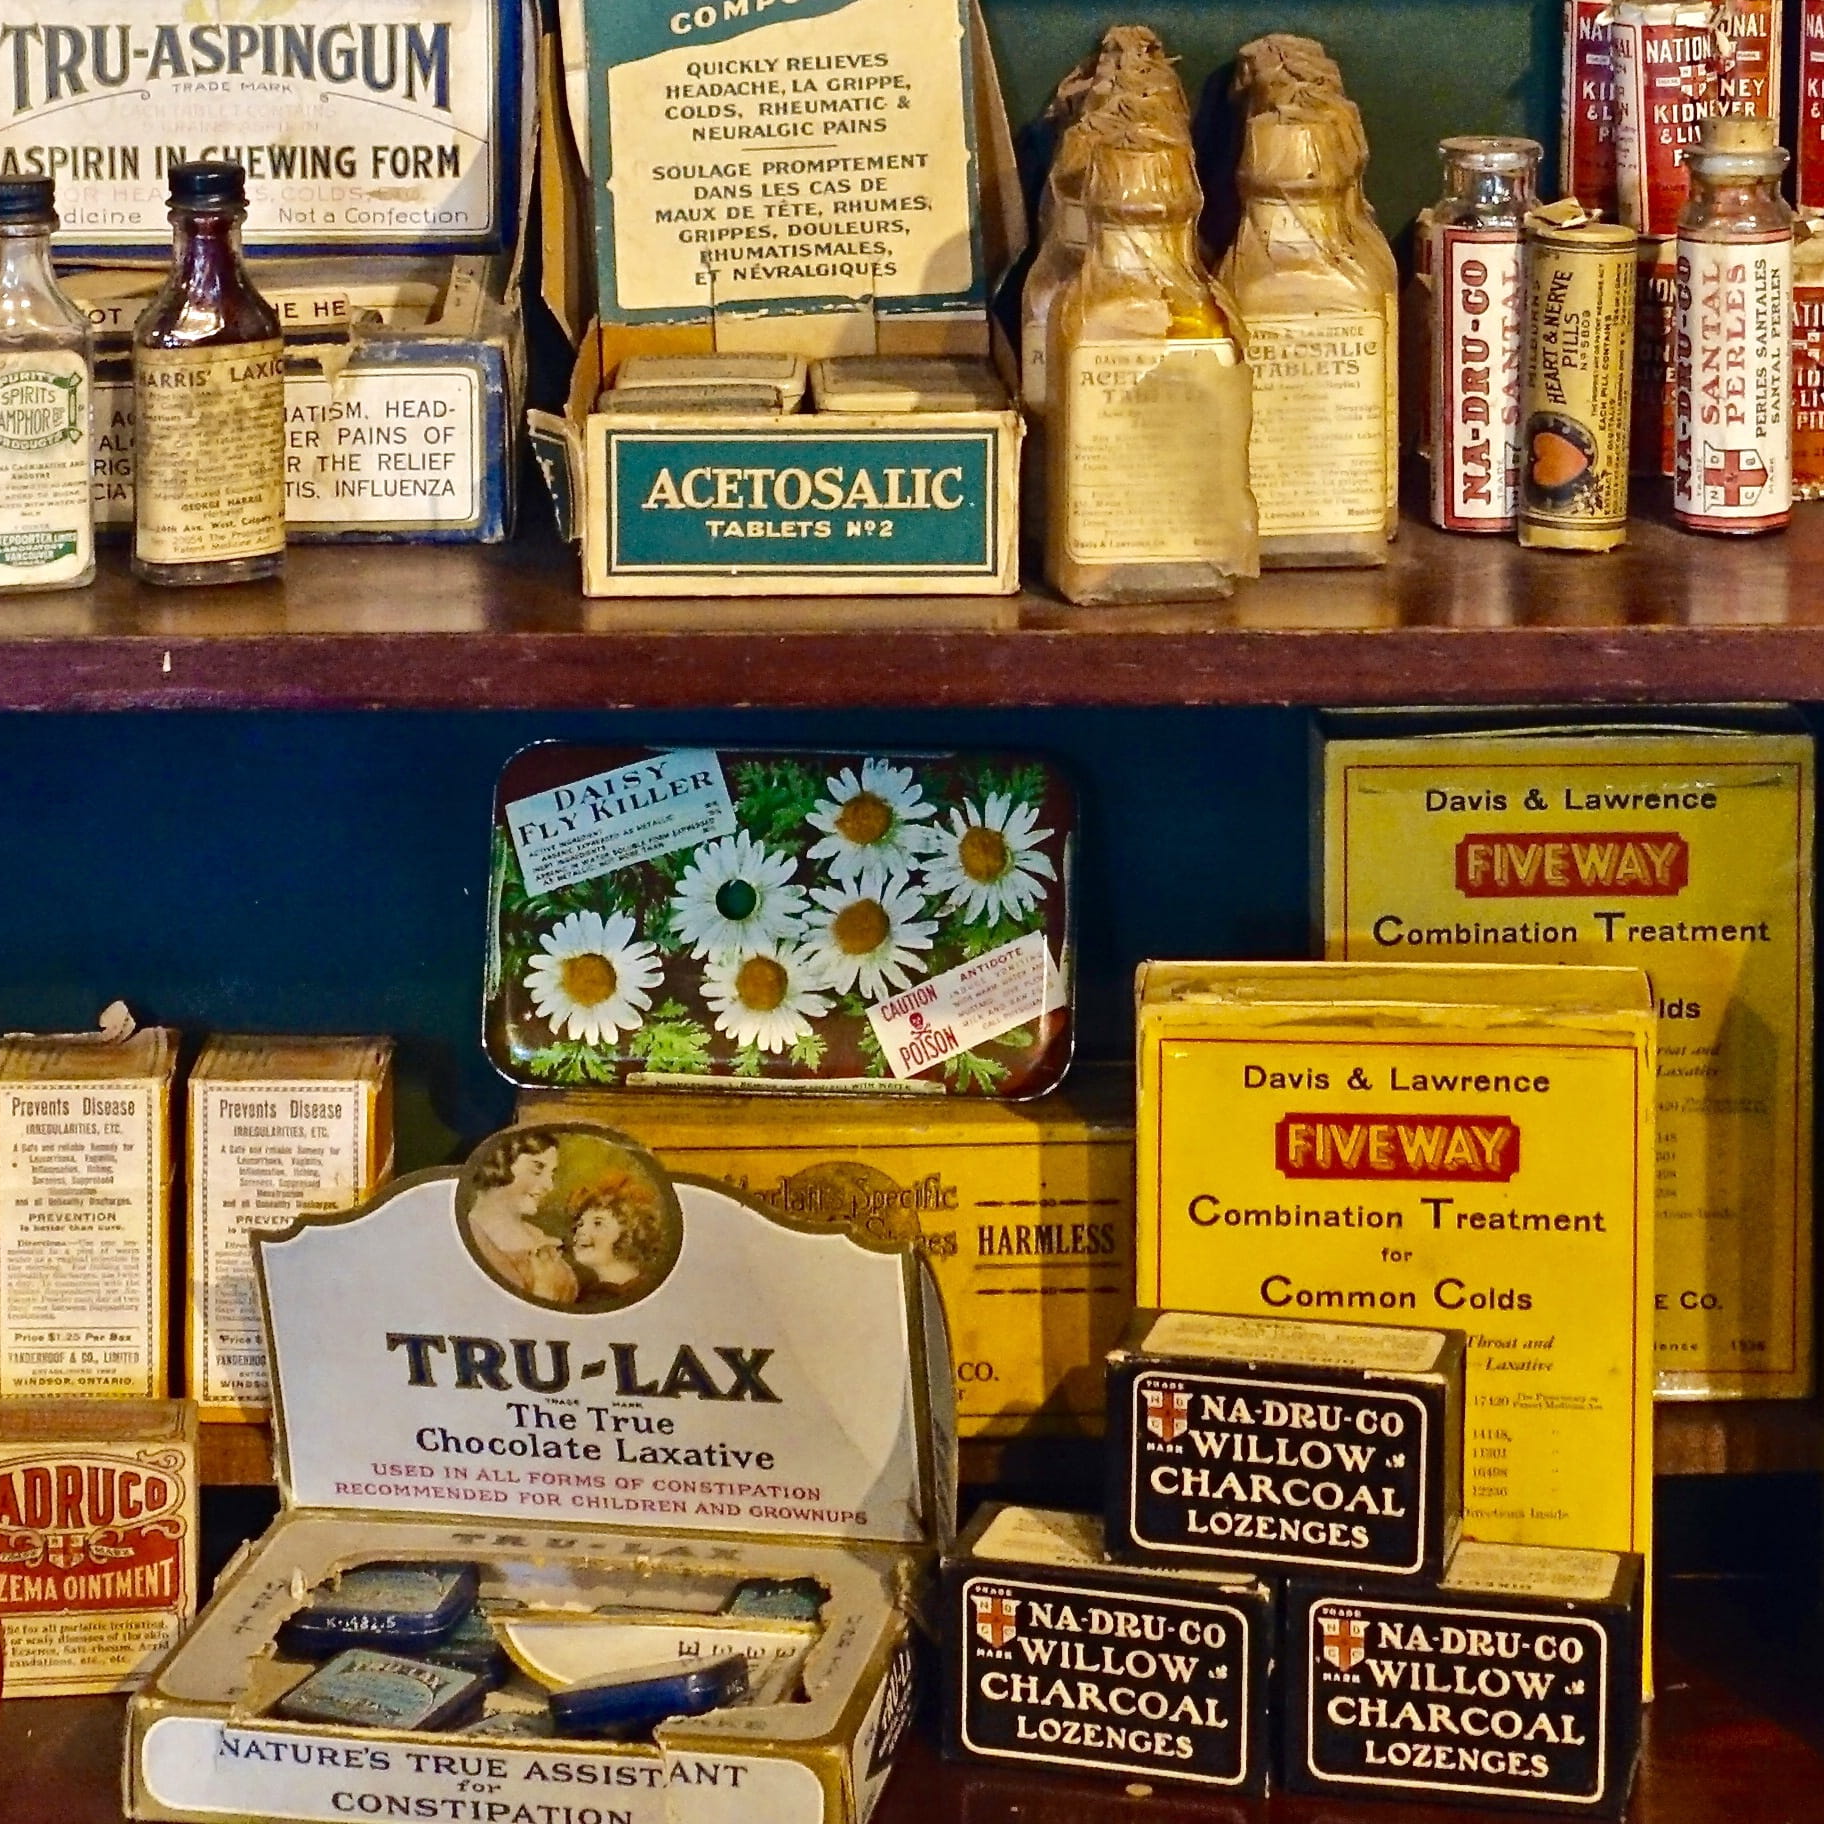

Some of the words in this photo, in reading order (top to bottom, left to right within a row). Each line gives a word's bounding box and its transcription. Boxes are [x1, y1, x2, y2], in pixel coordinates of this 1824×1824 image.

[686, 56, 779, 81] QUICKLY
[785, 52, 889, 73] RELIEVES
[665, 78, 787, 102] HEADACHE,
[826, 74, 912, 95] GRIPPE,
[664, 99, 743, 121] COLDS,
[758, 96, 888, 117] RHEUMATIC
[691, 120, 816, 142] NEURALGIC
[823, 117, 888, 137] PAINS
[0, 145, 142, 181] ASPIRIN
[371, 145, 461, 180] FORM
[277, 206, 316, 227] Not
[344, 206, 471, 228] Confection
[1700, 262, 1721, 425] SANTAL
[1726, 263, 1746, 425] PERLES
[0, 387, 57, 407] SPIRITS
[334, 478, 456, 500] INFLUENZA
[640, 464, 966, 512] ACETOSALIC
[705, 519, 832, 539] TABLETS
[552, 759, 669, 812] DAISY
[517, 804, 584, 848] FLY
[586, 769, 717, 825] KILLER
[879, 984, 938, 1023] CAUTION
[900, 1025, 960, 1070] POISON
[1242, 1065, 1329, 1093] Davis
[1390, 1064, 1552, 1096] Lawrence
[9, 1095, 75, 1120] Prevents
[80, 1095, 137, 1120] Disease
[1286, 1121, 1513, 1173] FIVEWAY
[1185, 1193, 1404, 1231] Combination
[1419, 1195, 1608, 1233] Treatment
[974, 1221, 1115, 1258] HARMLESS
[1258, 1274, 1416, 1311] Common
[1432, 1278, 1535, 1311] Colds
[384, 1330, 785, 1408] TRU-LAX
[504, 1399, 577, 1436] The
[585, 1405, 676, 1438] True
[412, 1429, 605, 1468] Chocolate
[615, 1438, 776, 1474] Laxative
[1187, 1432, 1379, 1474] WILLOW
[1149, 1466, 1407, 1518] CHARCOAL
[1186, 1509, 1372, 1552] LOZENGES
[61, 1557, 174, 1605] OINTMENT
[1327, 1695, 1587, 1746] CHARCOAL
[217, 1737, 392, 1773] NATURE'S
[405, 1752, 509, 1782] TRUE
[522, 1758, 750, 1793] ASSISTANT
